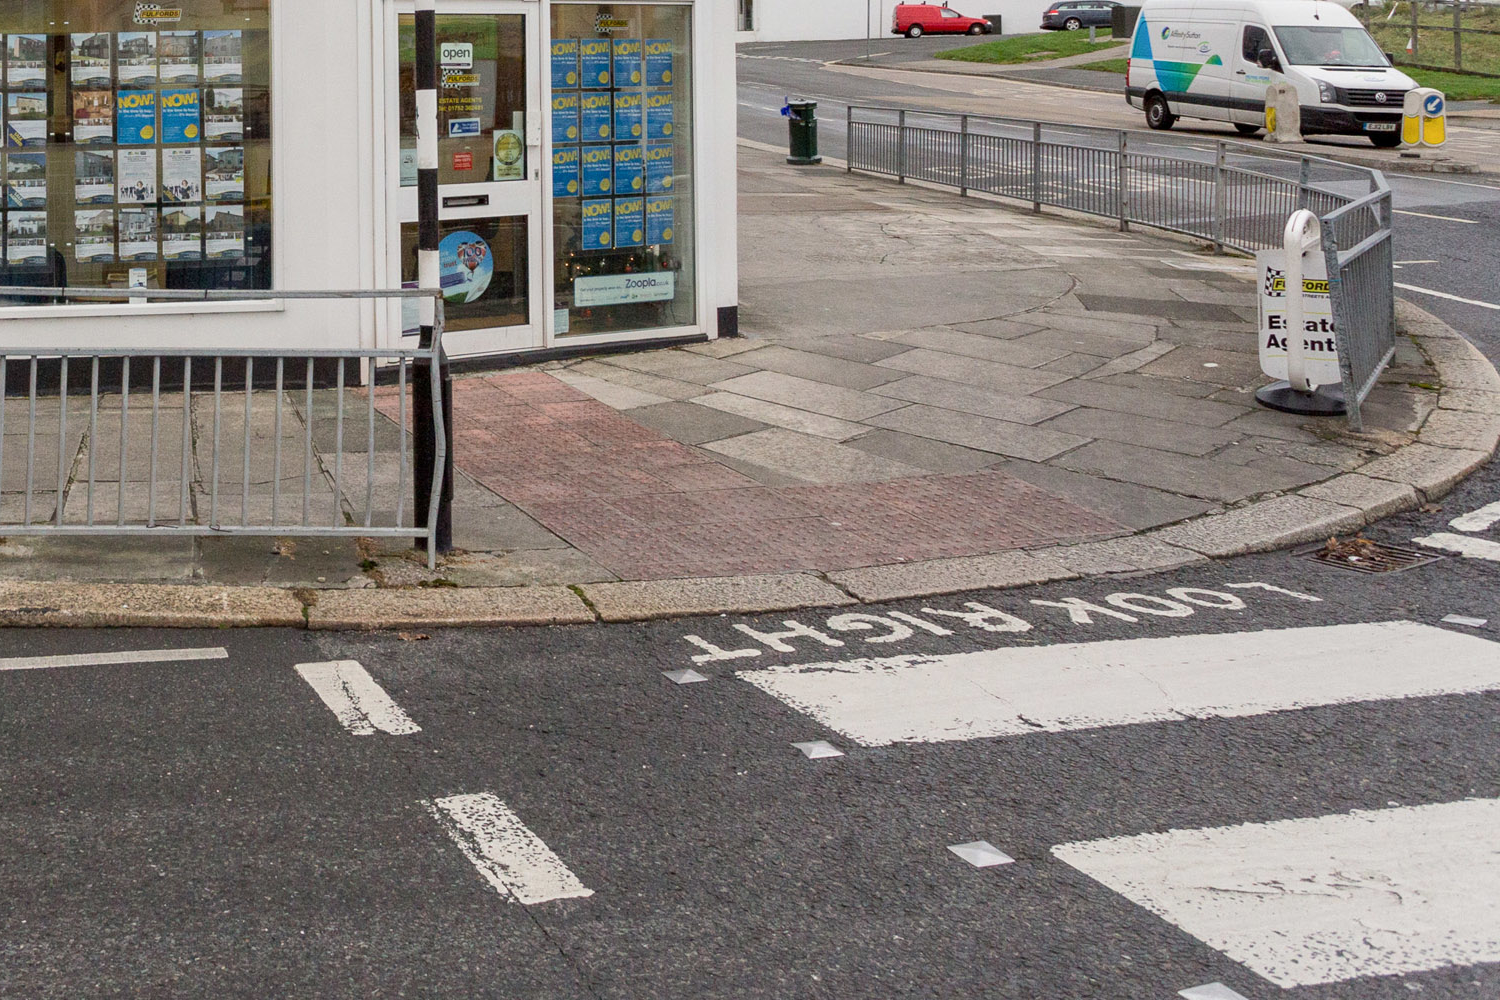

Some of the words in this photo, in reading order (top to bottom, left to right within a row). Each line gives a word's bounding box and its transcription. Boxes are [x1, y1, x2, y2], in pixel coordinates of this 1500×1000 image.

[443, 49, 470, 60] open
[582, 42, 609, 55] NOW!
[614, 42, 641, 55] NOW!
[118, 93, 155, 109] NOW!
[161, 91, 198, 108] NOW!
[582, 95, 609, 109] NOW!
[615, 94, 641, 108] NOW!
[647, 94, 673, 107] NOW!
[1029, 581, 1323, 623] LOOK
[682, 601, 1033, 664] RIGHT
